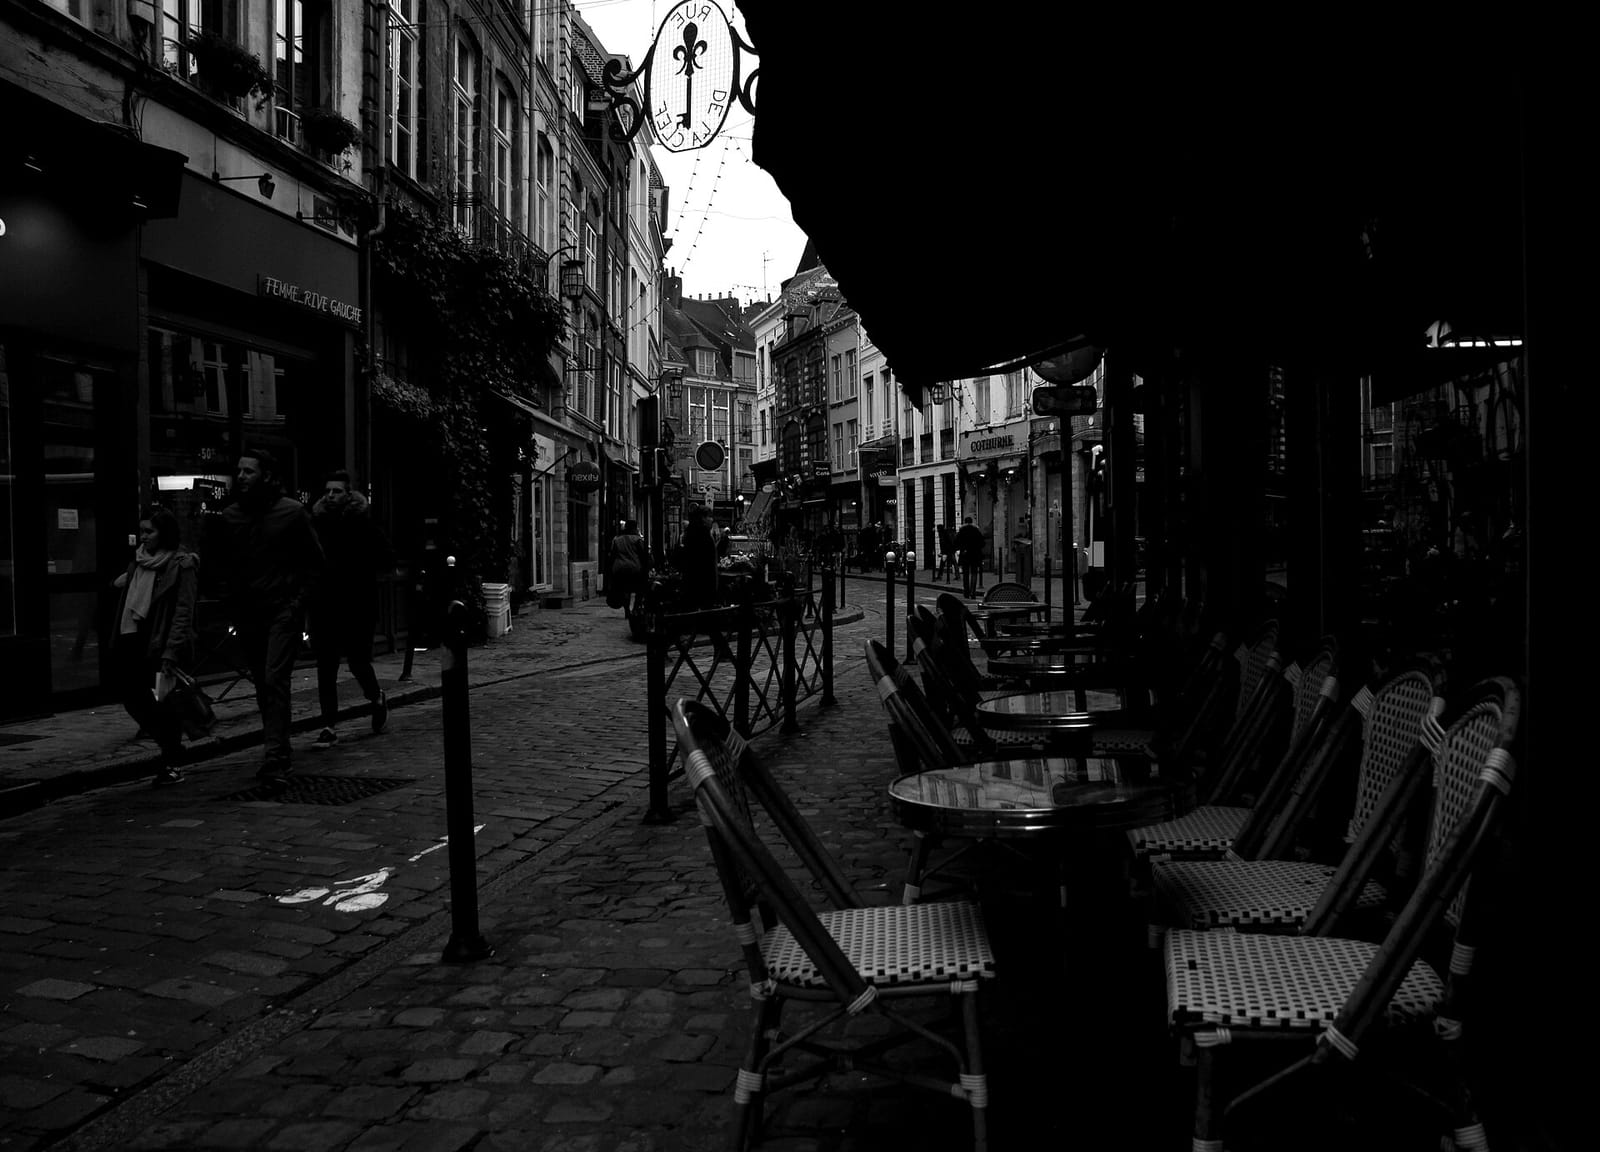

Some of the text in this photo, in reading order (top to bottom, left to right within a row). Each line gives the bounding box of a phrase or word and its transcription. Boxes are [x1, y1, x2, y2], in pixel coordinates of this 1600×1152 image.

[330, 299, 363, 324] GAUCHE
[970, 434, 1015, 452] COTHURNE
[571, 472, 600, 482] nexity
